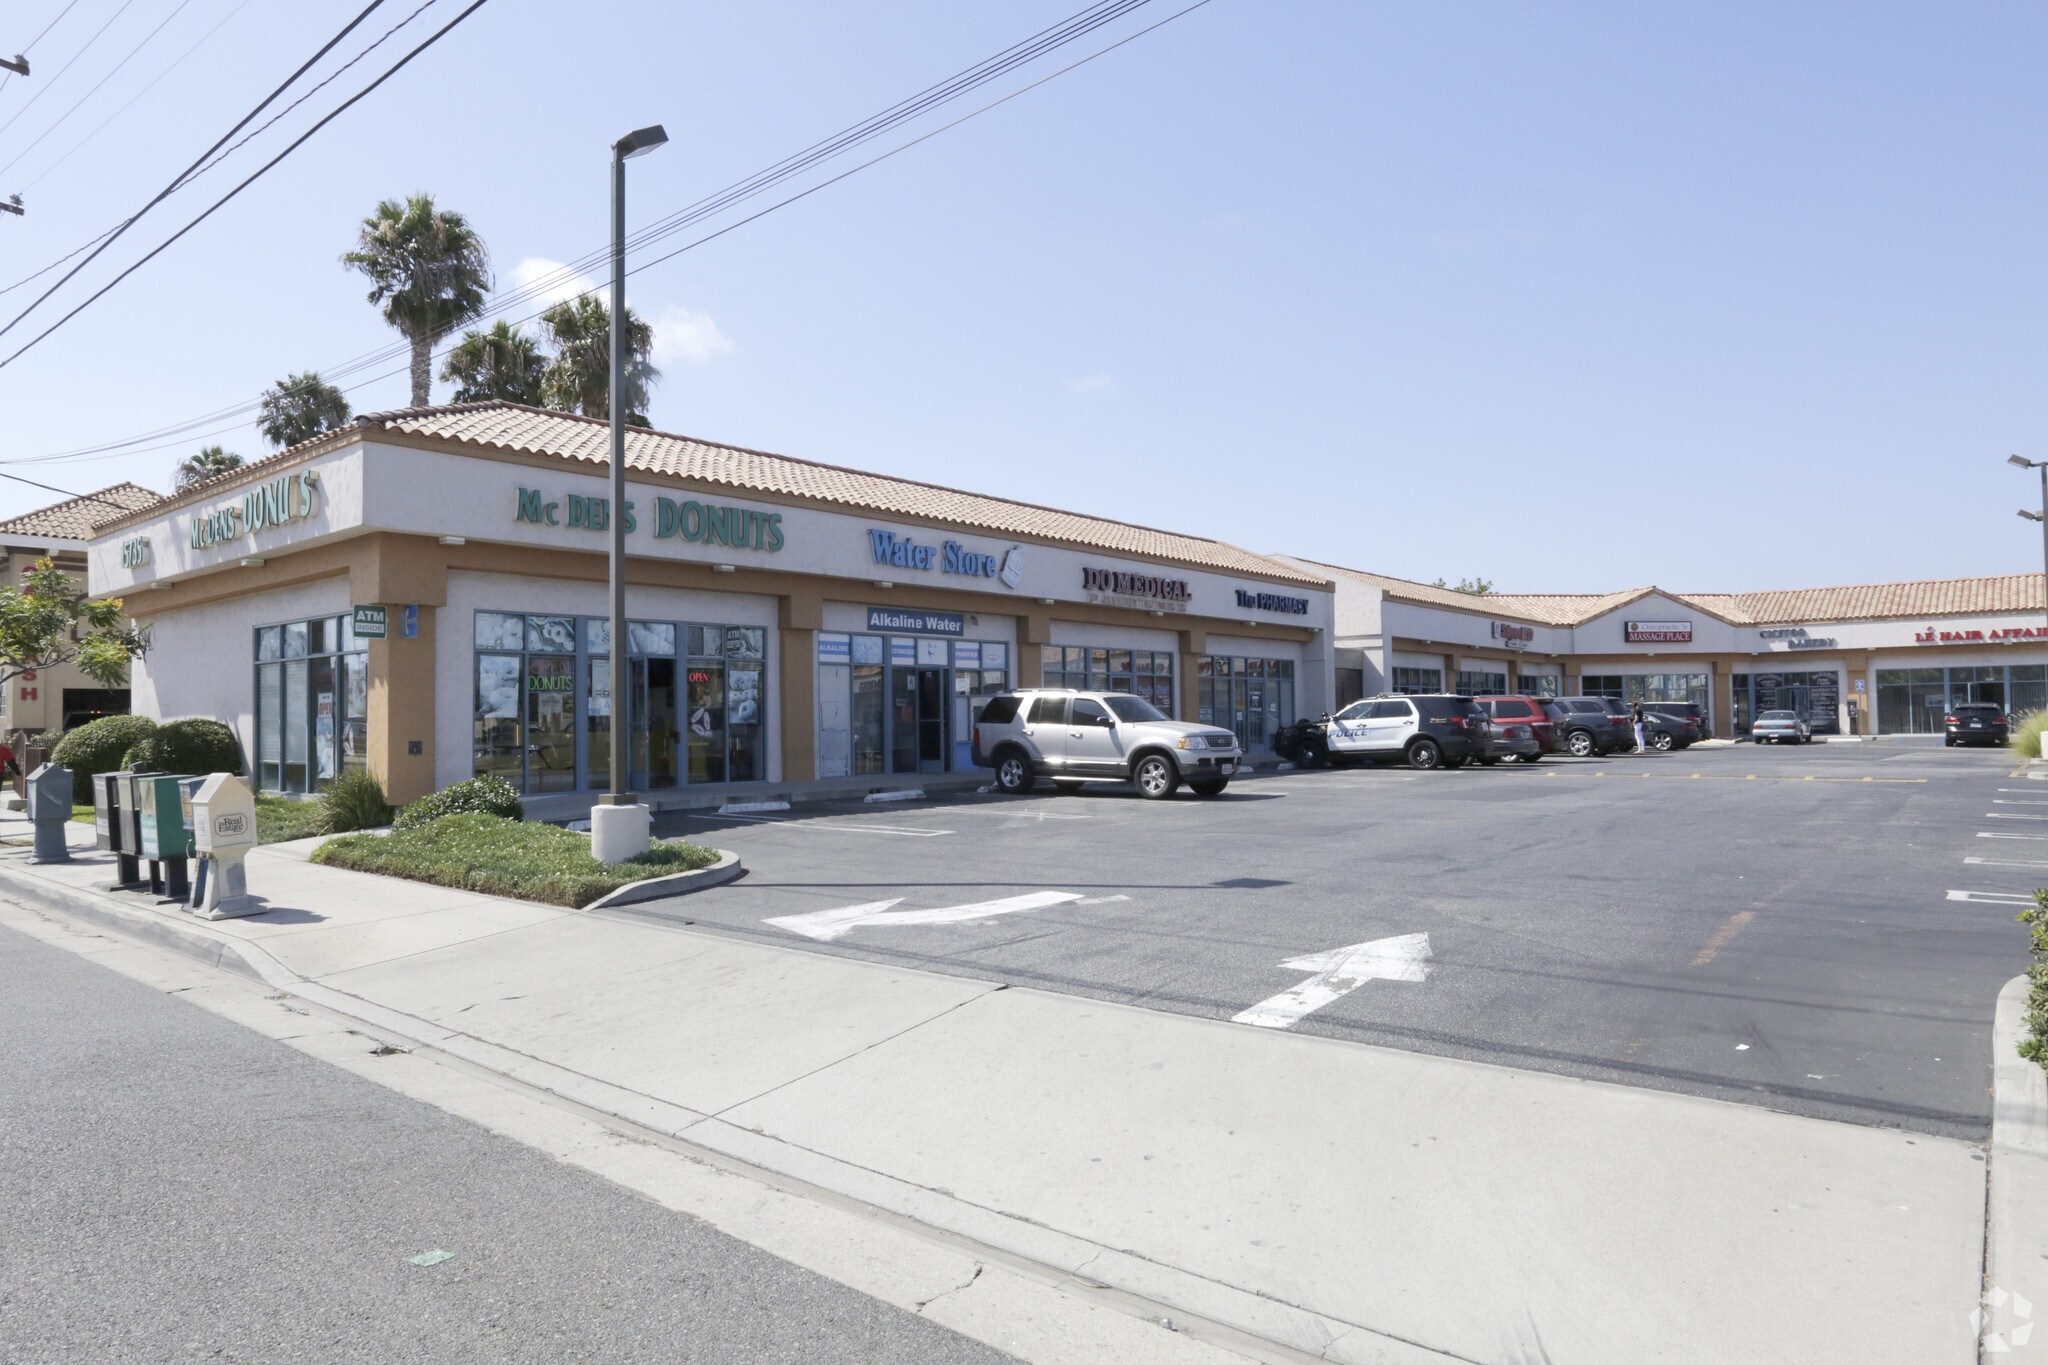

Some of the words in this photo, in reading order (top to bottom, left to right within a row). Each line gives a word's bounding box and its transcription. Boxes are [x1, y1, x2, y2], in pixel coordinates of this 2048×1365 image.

[516, 487, 559, 526] Mc
[656, 496, 785, 552] DONUTS
[867, 529, 937, 571] Water
[942, 540, 997, 578] Store
[1083, 567, 1112, 591] DO
[1113, 572, 1192, 601] MEDICAL
[1257, 593, 1309, 614] PHARMACY
[356, 610, 385, 622] ATM
[870, 612, 923, 629] Alkaline
[926, 616, 962, 632] Water
[1641, 623, 1679, 631] Chiropractic
[357, 624, 383, 632] INSIDE
[727, 630, 740, 640] ATM
[1629, 632, 1666, 641] MASSAGE
[1666, 632, 1690, 641] PLACE
[1940, 630, 1984, 641] HAIR
[819, 644, 849, 652] ALKALINE
[688, 671, 709, 682] OPEN
[528, 675, 573, 690] DONUTS
[1328, 728, 1368, 738] POLICE
[224, 816, 242, 825] Real
[218, 823, 243, 832] Estate
